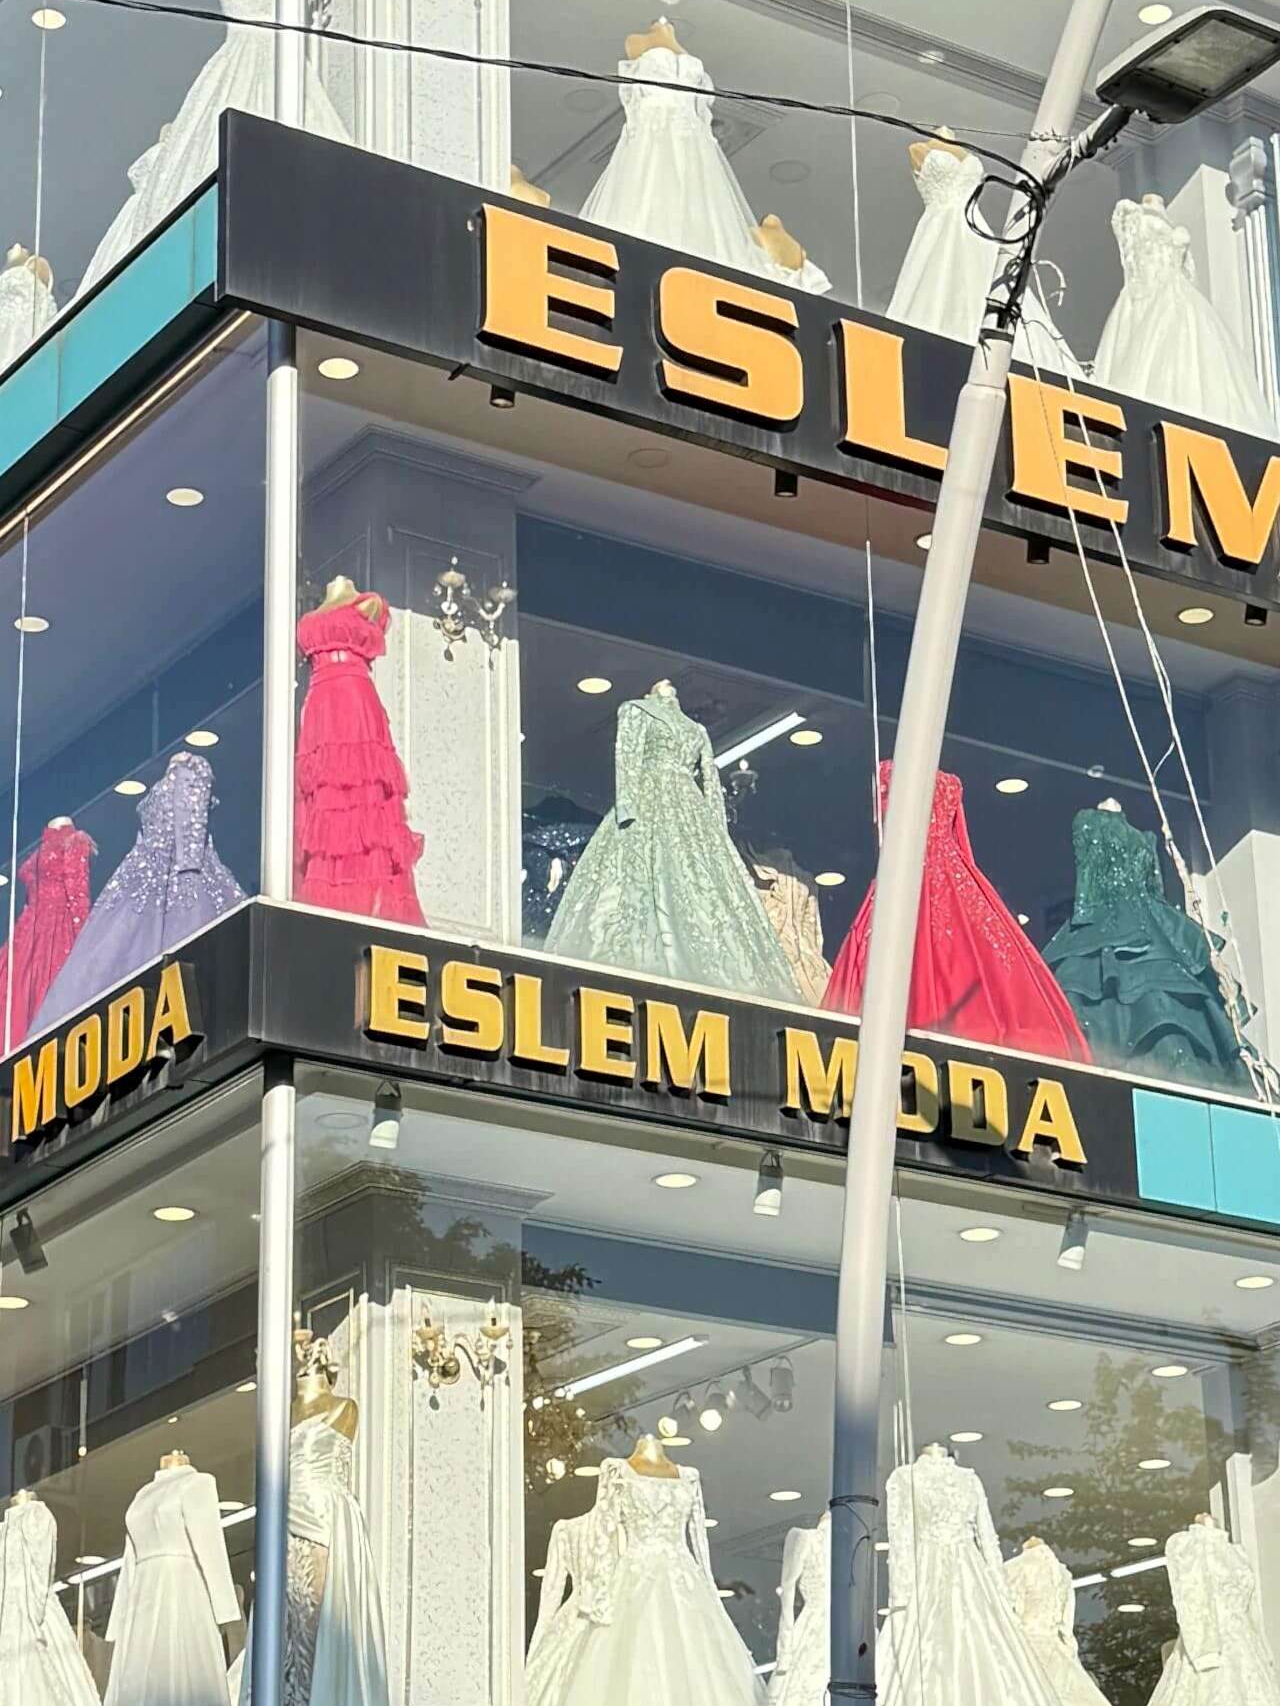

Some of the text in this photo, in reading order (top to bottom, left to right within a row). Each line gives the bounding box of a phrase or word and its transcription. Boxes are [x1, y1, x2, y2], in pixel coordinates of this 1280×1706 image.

[10, 960, 195, 1143] MODA
[365, 944, 1089, 1165] ESLEM MODA
